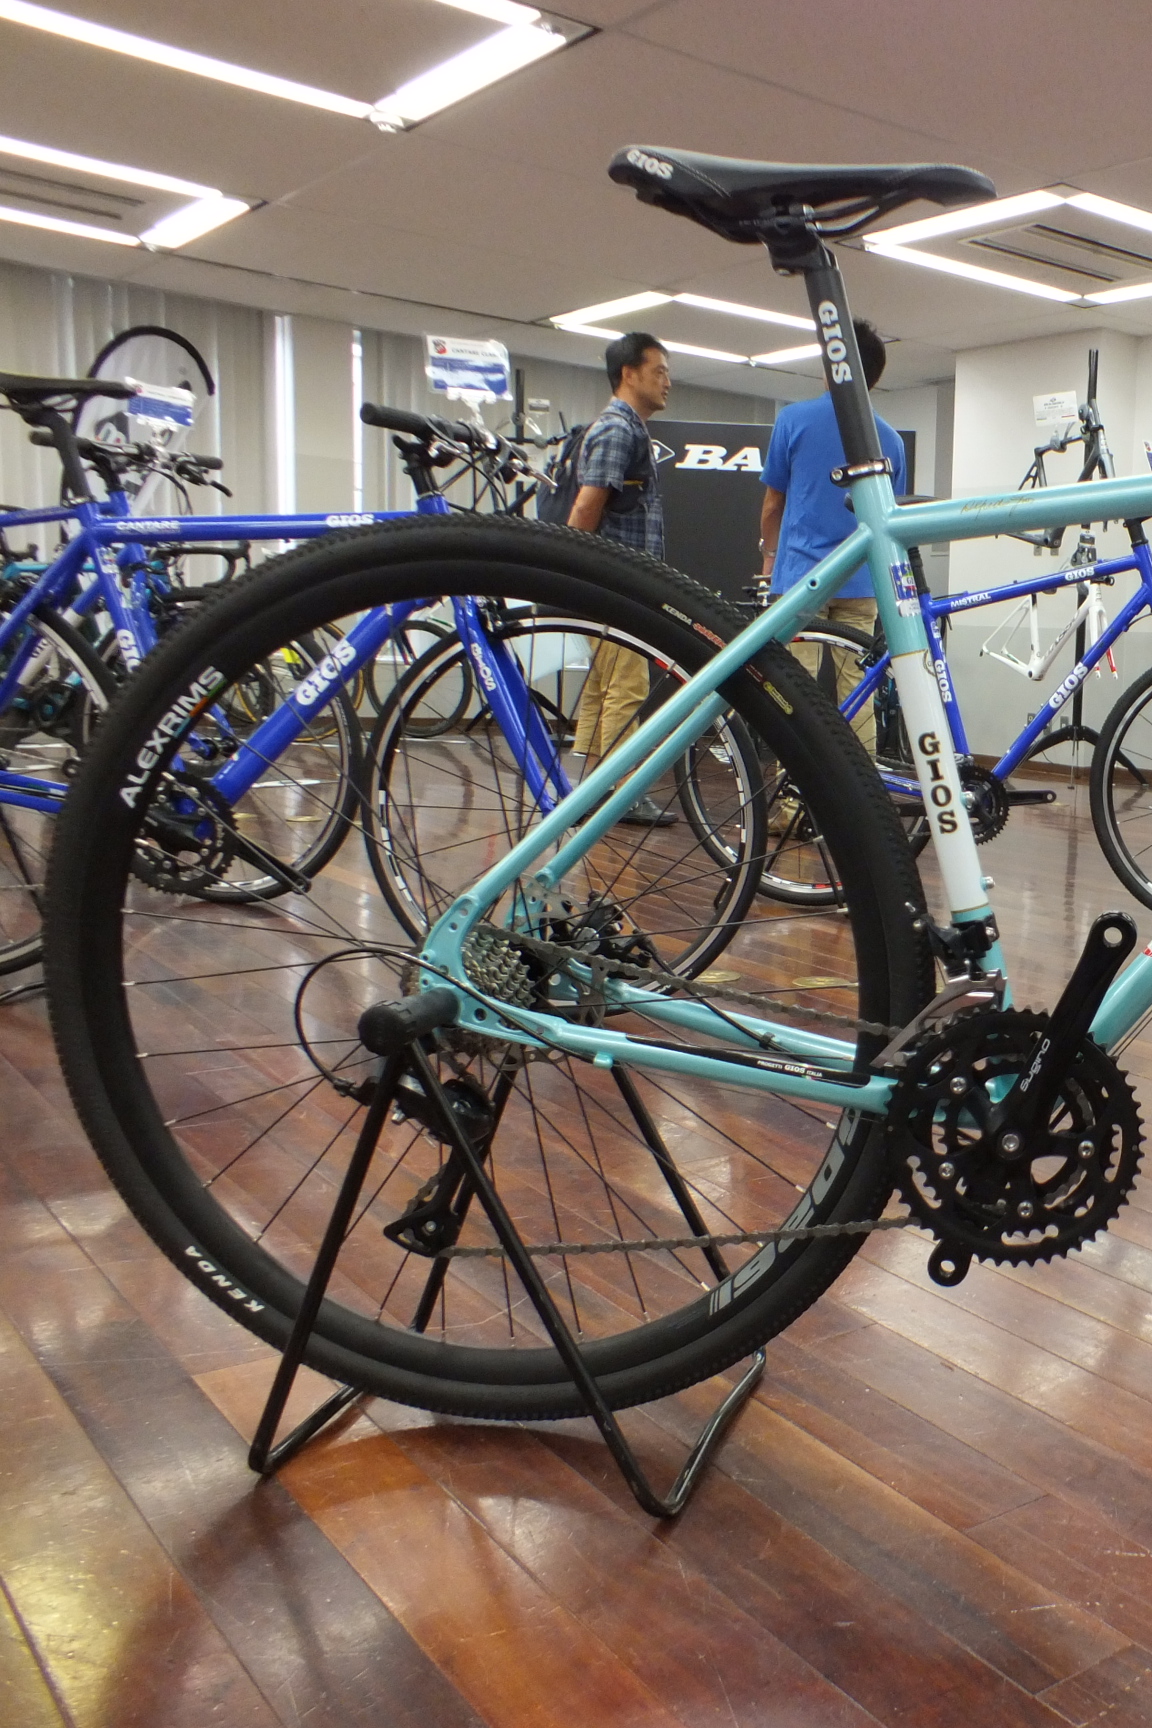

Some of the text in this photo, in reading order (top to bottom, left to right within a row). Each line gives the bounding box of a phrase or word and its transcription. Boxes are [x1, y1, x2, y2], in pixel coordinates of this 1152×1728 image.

[627, 149, 674, 180] GIOS
[818, 301, 852, 384] GIOS
[115, 520, 180, 532] CANTARE
[326, 513, 375, 528] GIOS
[1064, 567, 1096, 582] GIOS
[661, 602, 693, 626] KENDA
[950, 592, 992, 609] MISTRAL
[295, 640, 357, 706] GIOS
[470, 642, 497, 692] GIOS
[935, 659, 953, 703] GIOS
[1049, 660, 1090, 709] GIOS
[119, 665, 226, 809] ALEXRIMS
[917, 731, 959, 835] GIOS
[757, 1060, 823, 1078] PROGETTI GIOS ITALIA
[184, 1245, 265, 1312] KENDA
